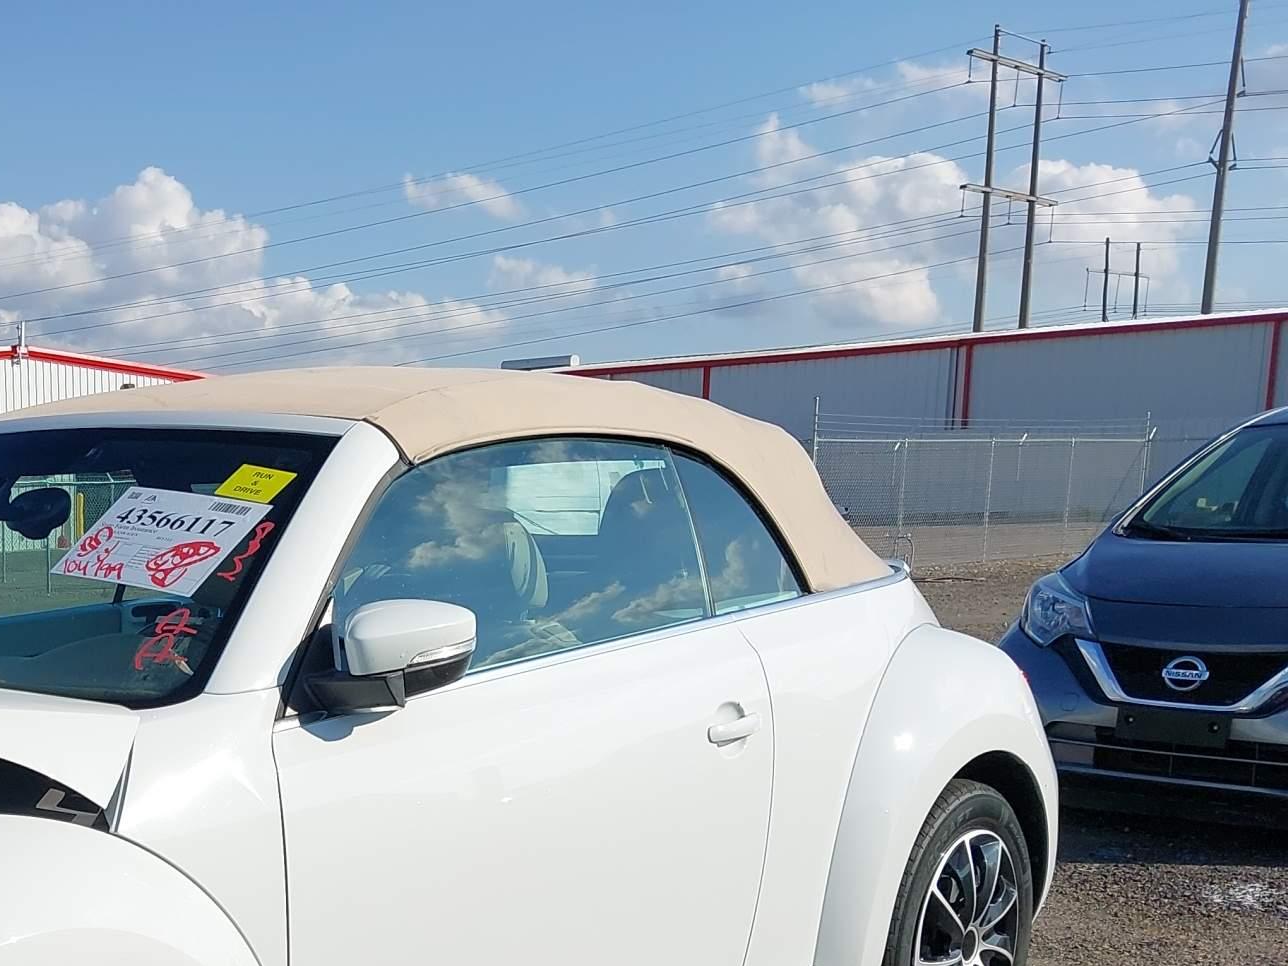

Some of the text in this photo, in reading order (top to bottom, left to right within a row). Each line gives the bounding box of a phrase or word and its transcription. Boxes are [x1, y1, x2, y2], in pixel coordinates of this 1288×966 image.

[253, 471, 274, 480] RUN
[233, 485, 262, 496] DRIVE
[116, 507, 235, 537] 43566117
[1165, 670, 1203, 679] NISSAN
